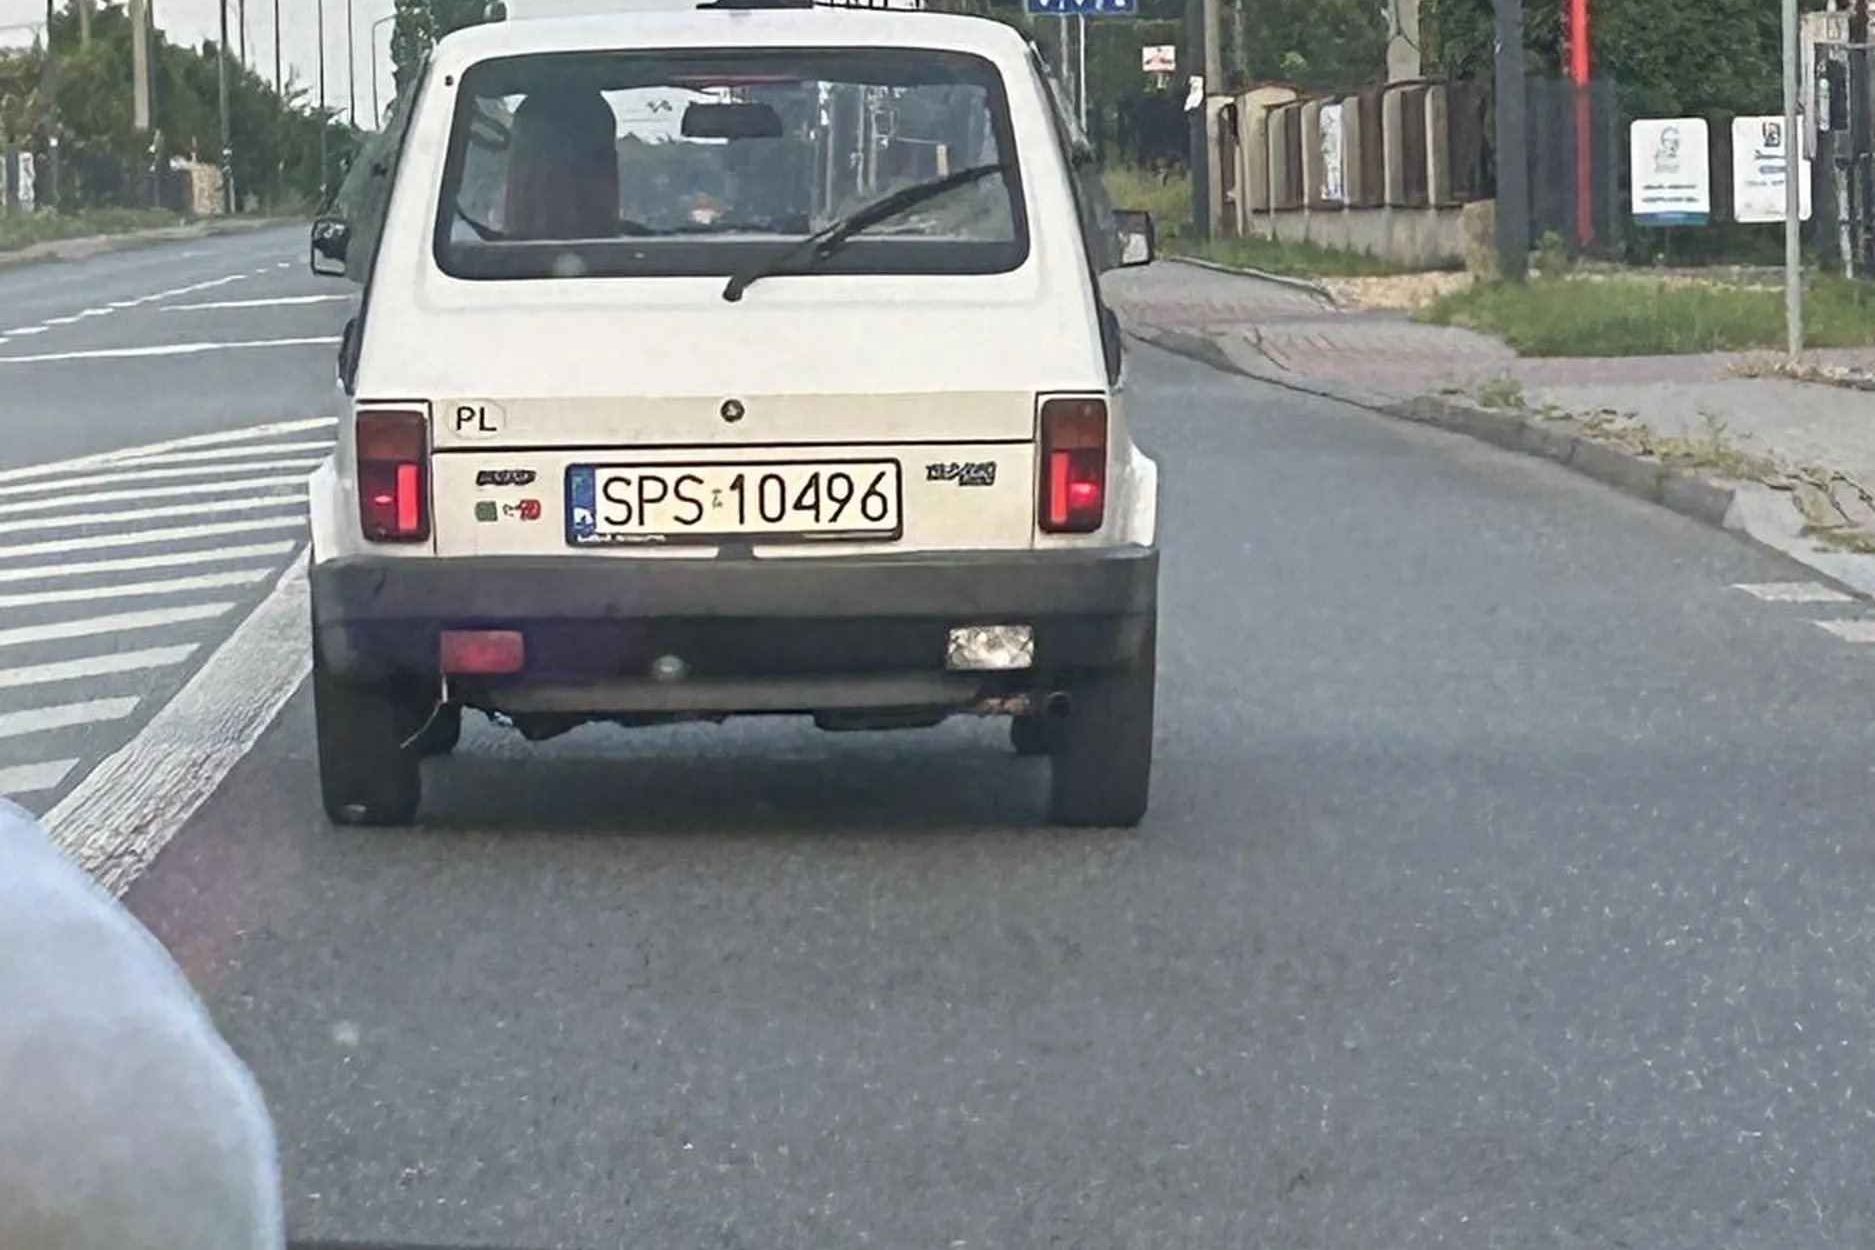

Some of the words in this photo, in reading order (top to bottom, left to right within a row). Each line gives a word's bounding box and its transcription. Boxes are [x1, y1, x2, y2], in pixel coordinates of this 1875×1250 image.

[456, 406, 498, 431] PL
[602, 474, 705, 526] SPS
[729, 471, 889, 525] 10496
